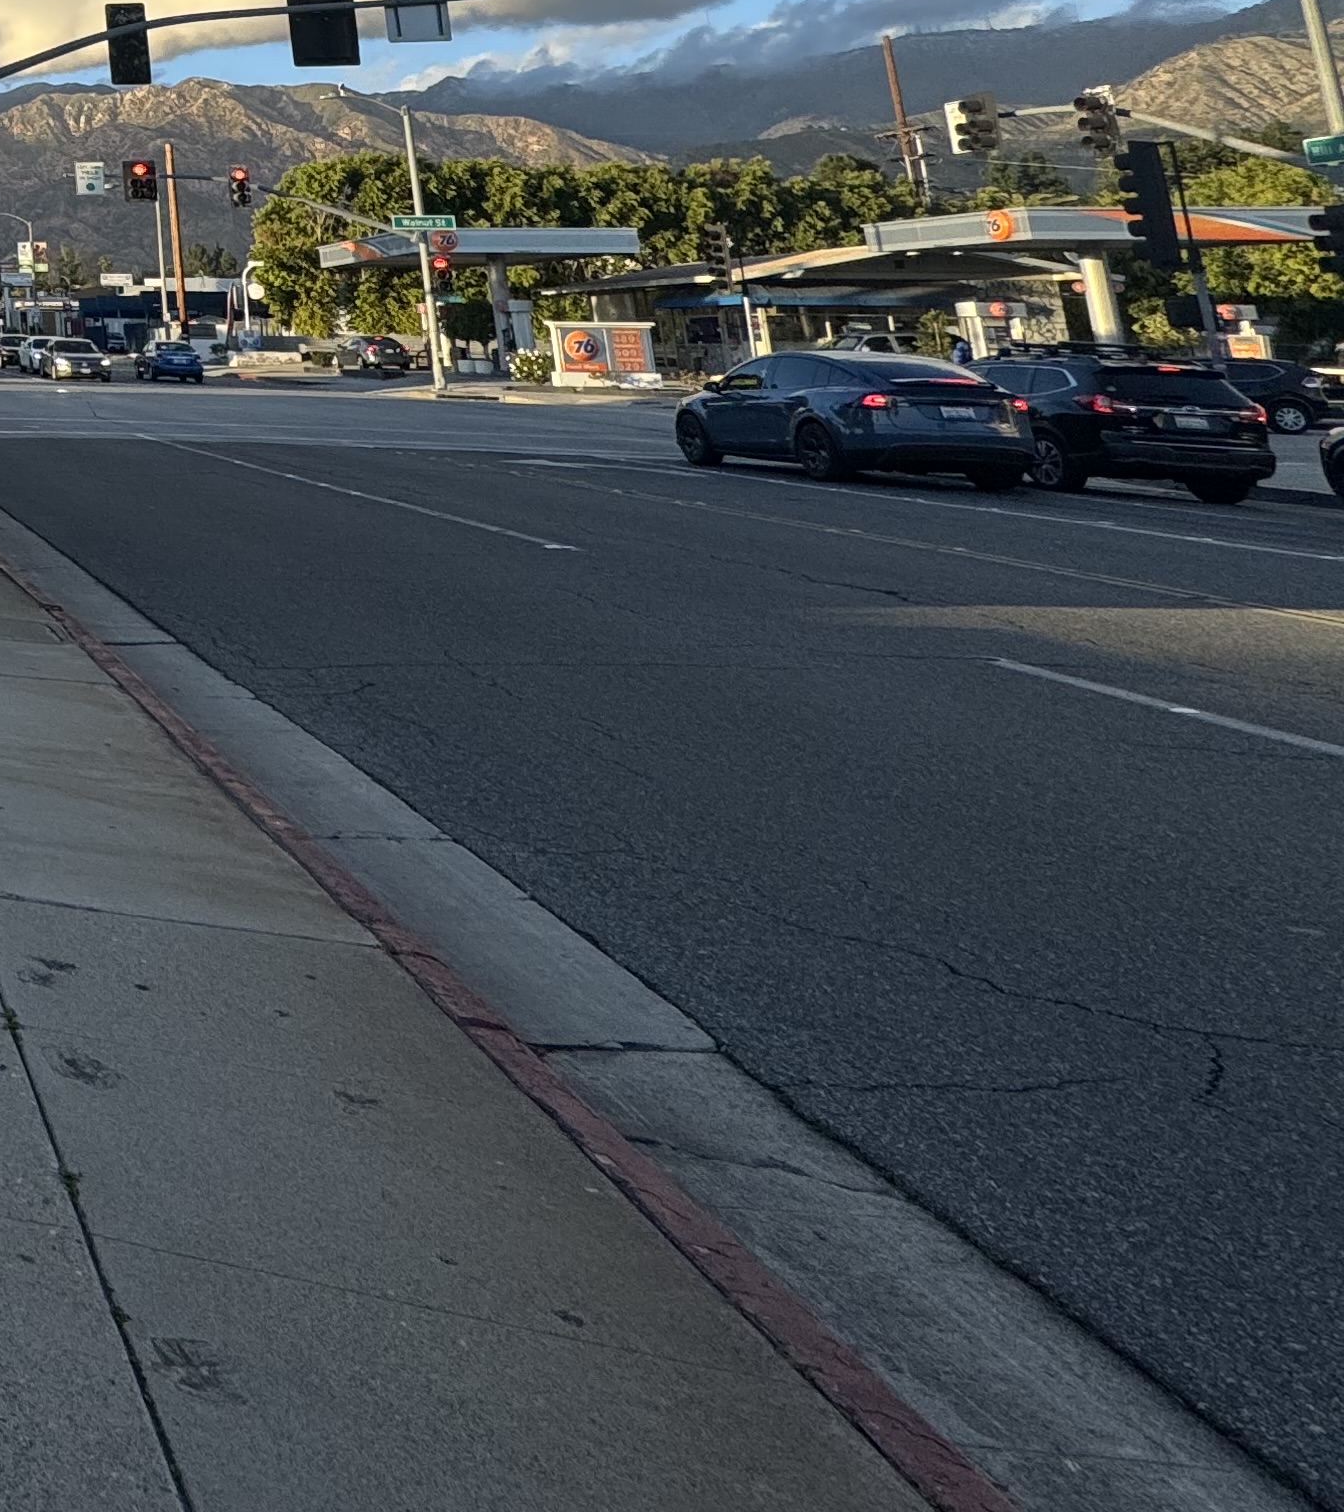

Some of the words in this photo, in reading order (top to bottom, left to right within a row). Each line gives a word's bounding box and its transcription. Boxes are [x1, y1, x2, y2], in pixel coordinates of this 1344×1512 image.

[400, 218, 433, 227] Walnut
[434, 219, 447, 227] St
[439, 234, 455, 246] 76
[573, 338, 596, 354] 76
